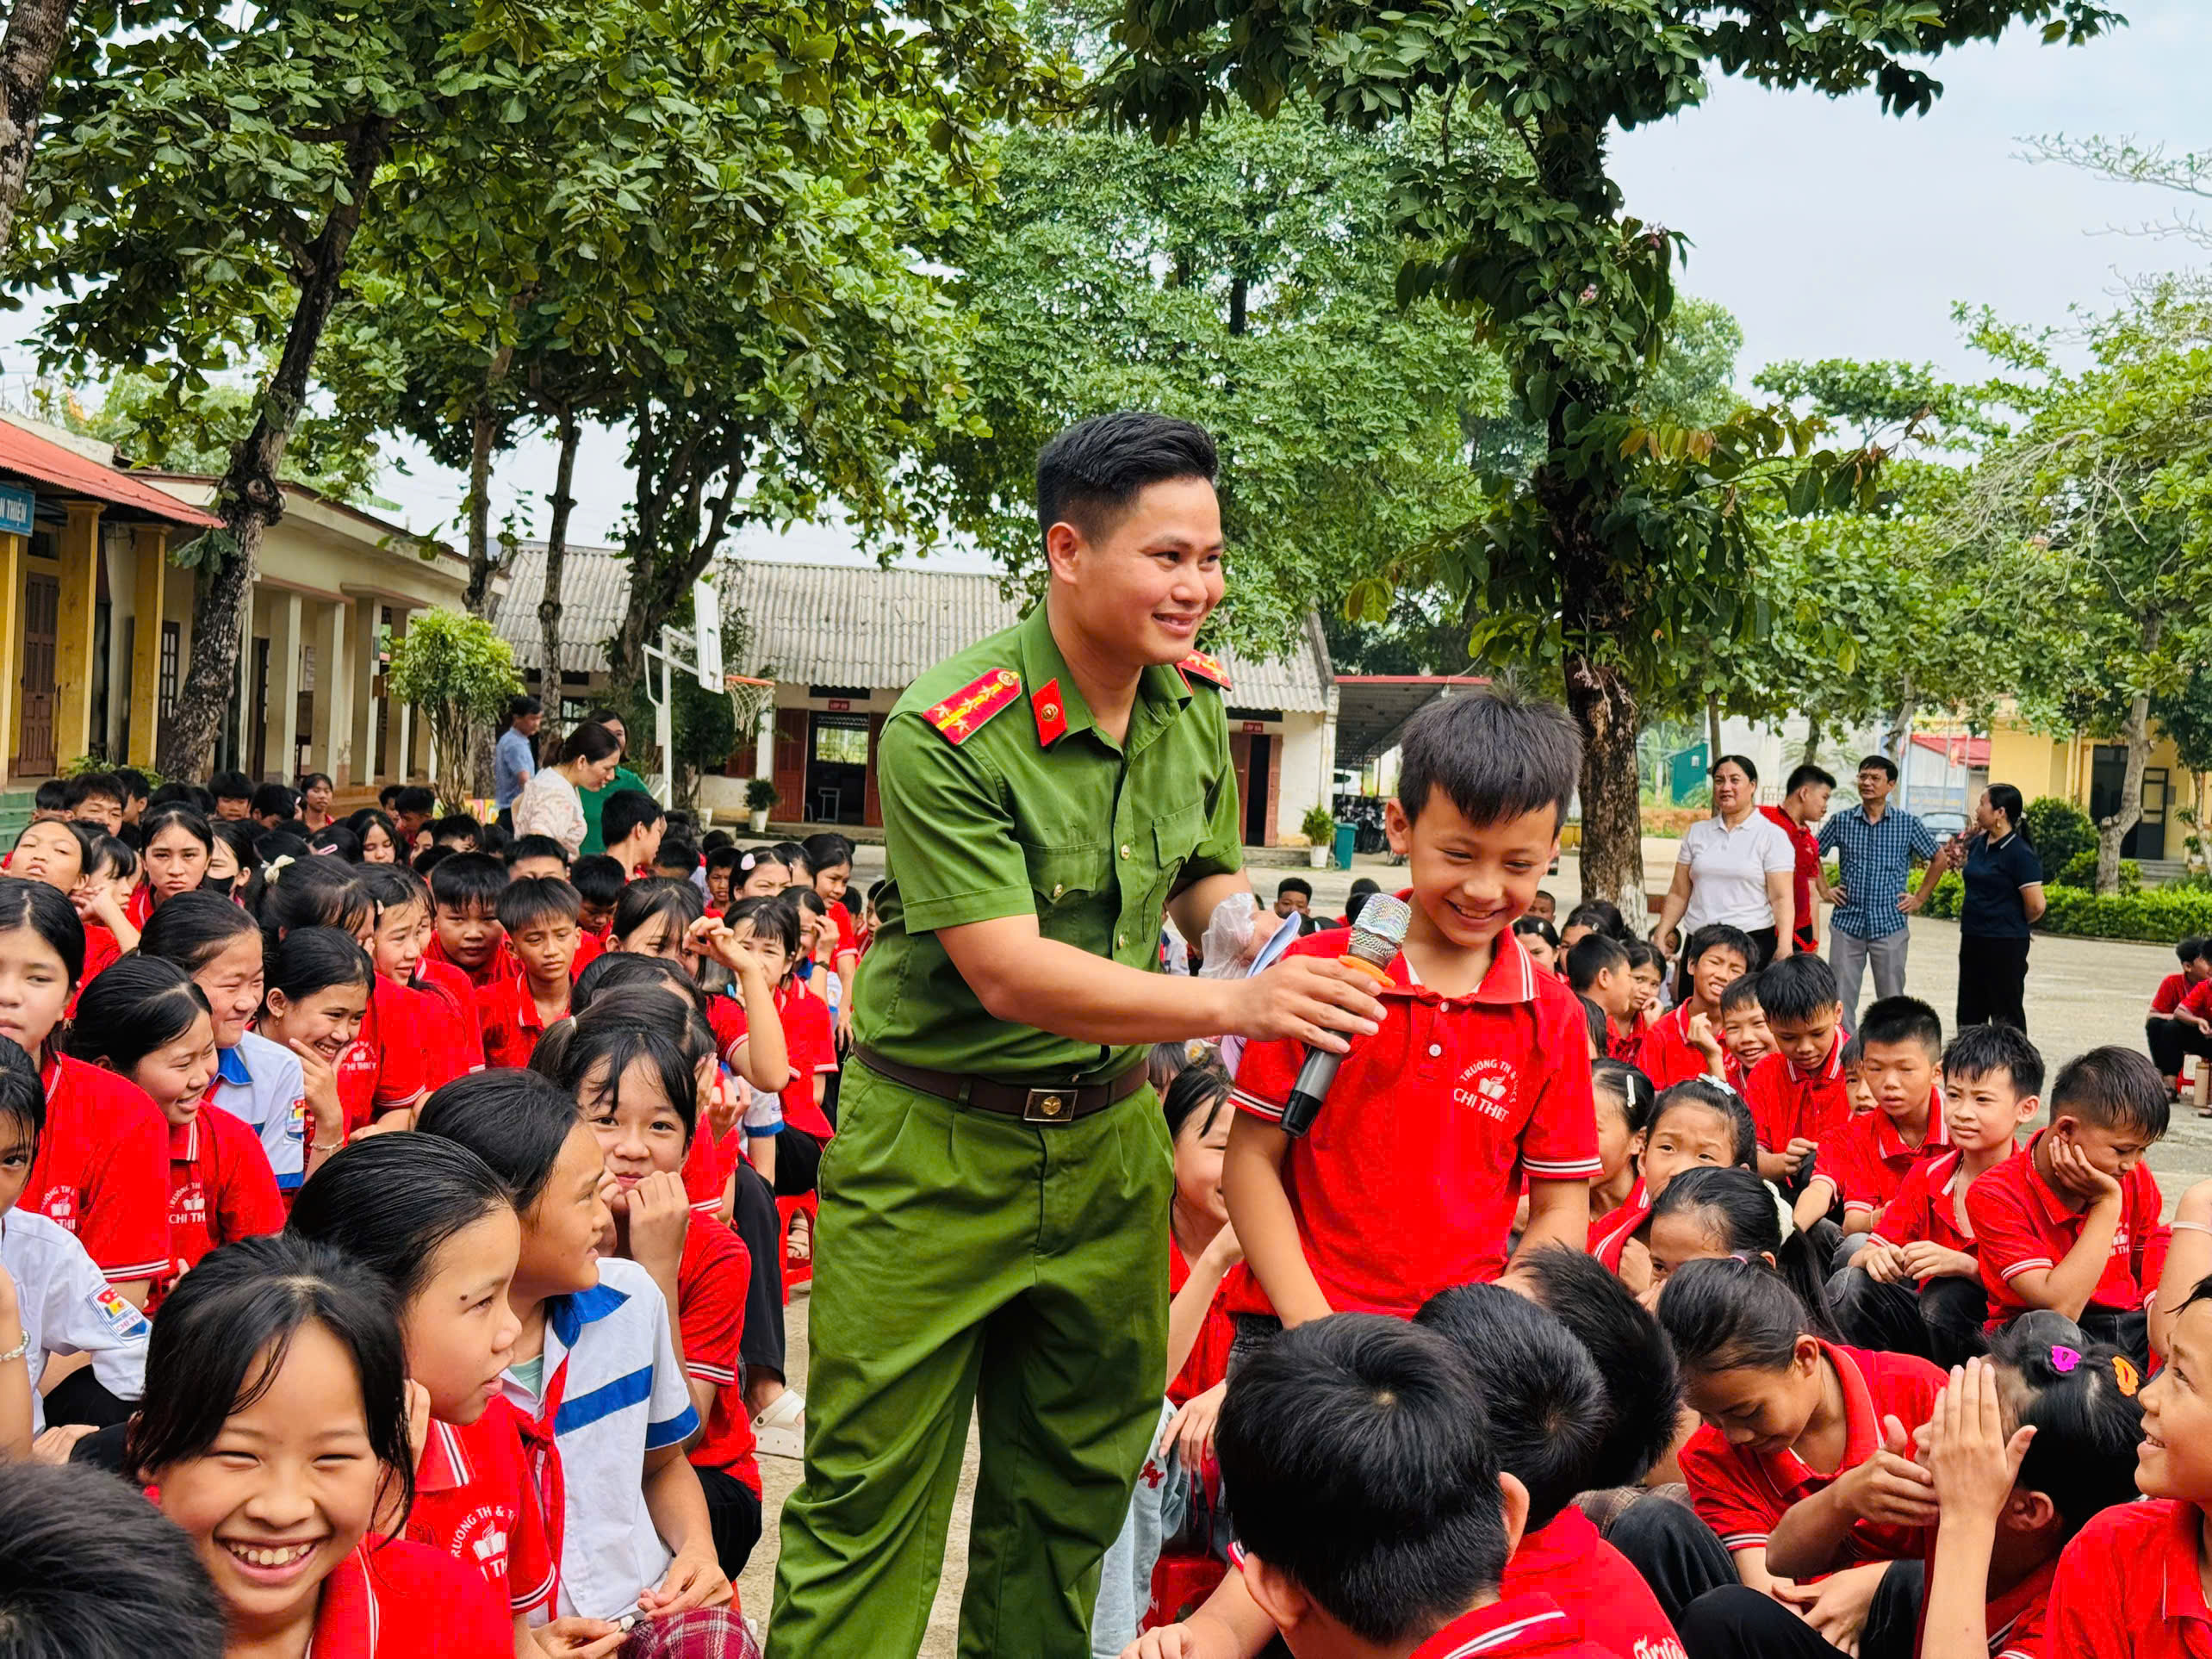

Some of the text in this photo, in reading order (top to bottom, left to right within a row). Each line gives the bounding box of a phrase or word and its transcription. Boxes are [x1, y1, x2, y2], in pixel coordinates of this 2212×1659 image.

[1453, 1087, 1478, 1109] CHI
[168, 1213, 187, 1224] CHI
[475, 1506, 493, 1519] TH
[495, 1505, 505, 1517] &
